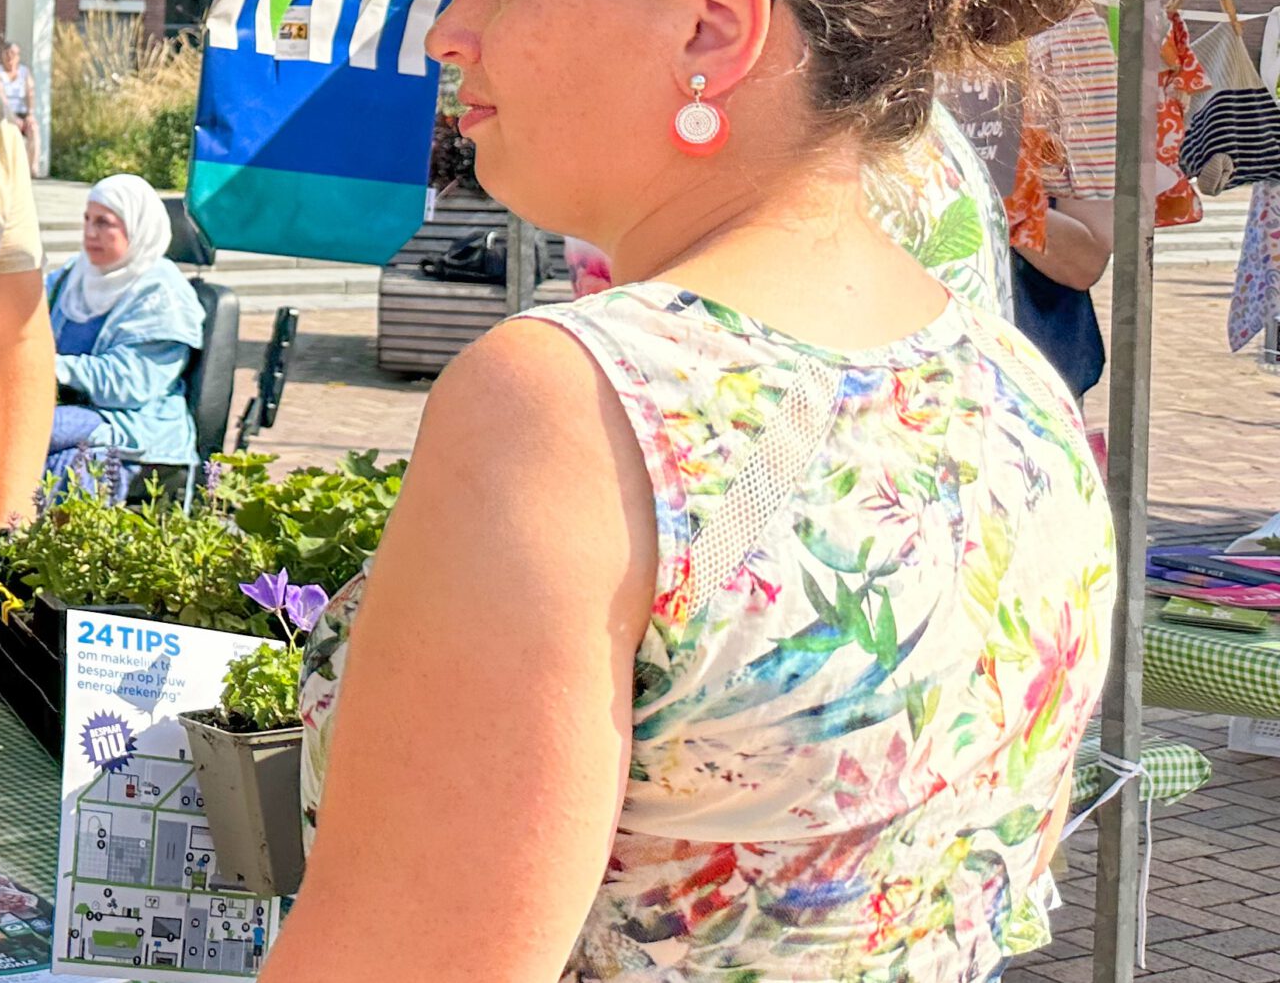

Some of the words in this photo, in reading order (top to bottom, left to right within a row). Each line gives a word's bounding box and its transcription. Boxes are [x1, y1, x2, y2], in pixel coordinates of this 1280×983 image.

[77, 650, 98, 661] om
[137, 673, 154, 685] op
[156, 673, 186, 687] jouw
